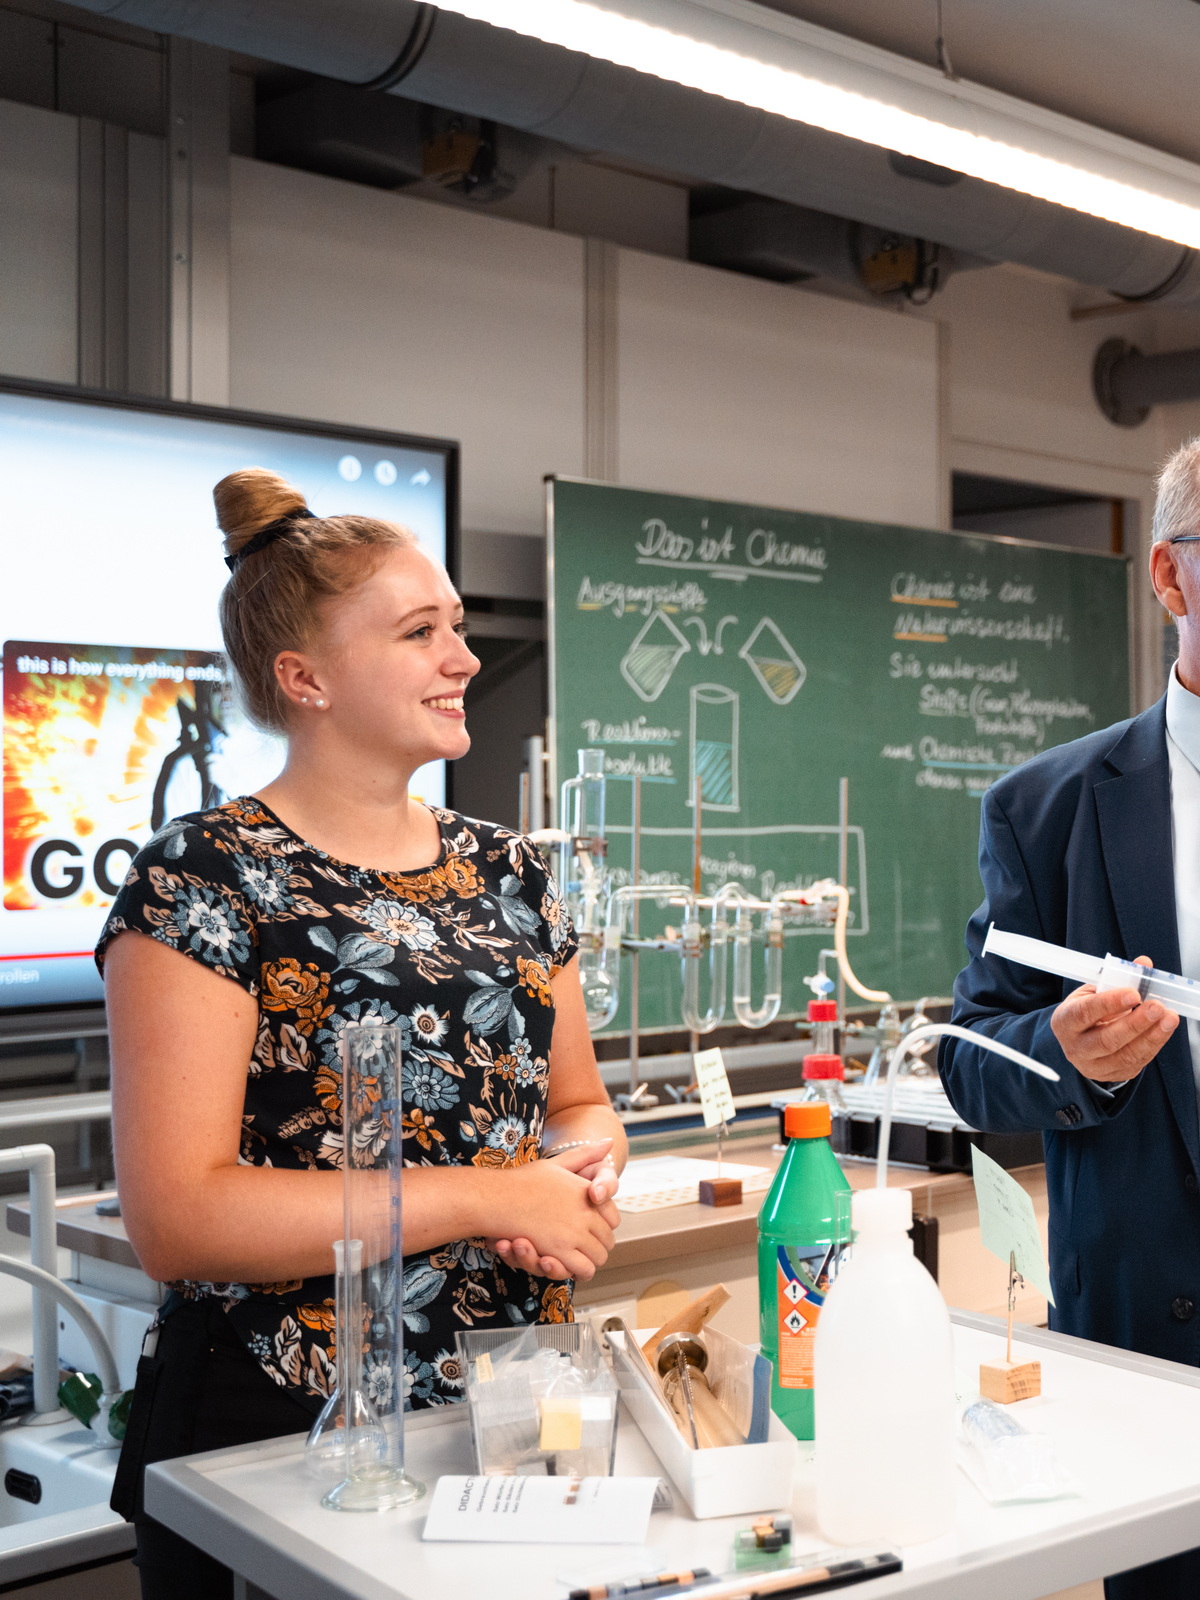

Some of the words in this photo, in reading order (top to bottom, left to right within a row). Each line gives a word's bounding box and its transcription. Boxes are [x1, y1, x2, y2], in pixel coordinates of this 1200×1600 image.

[634, 518, 694, 560] Das
[697, 517, 736, 561] ist
[745, 528, 828, 570] Chemie
[890, 571, 957, 600] Chemie
[958, 573, 991, 600] ist
[16, 655, 49, 674] this
[50, 656, 68, 675] is
[68, 657, 104, 676] how
[104, 661, 185, 683] everything
[889, 652, 922, 679] Sie
[927, 656, 1019, 684] untersucht
[603, 751, 674, 776] rodukte
